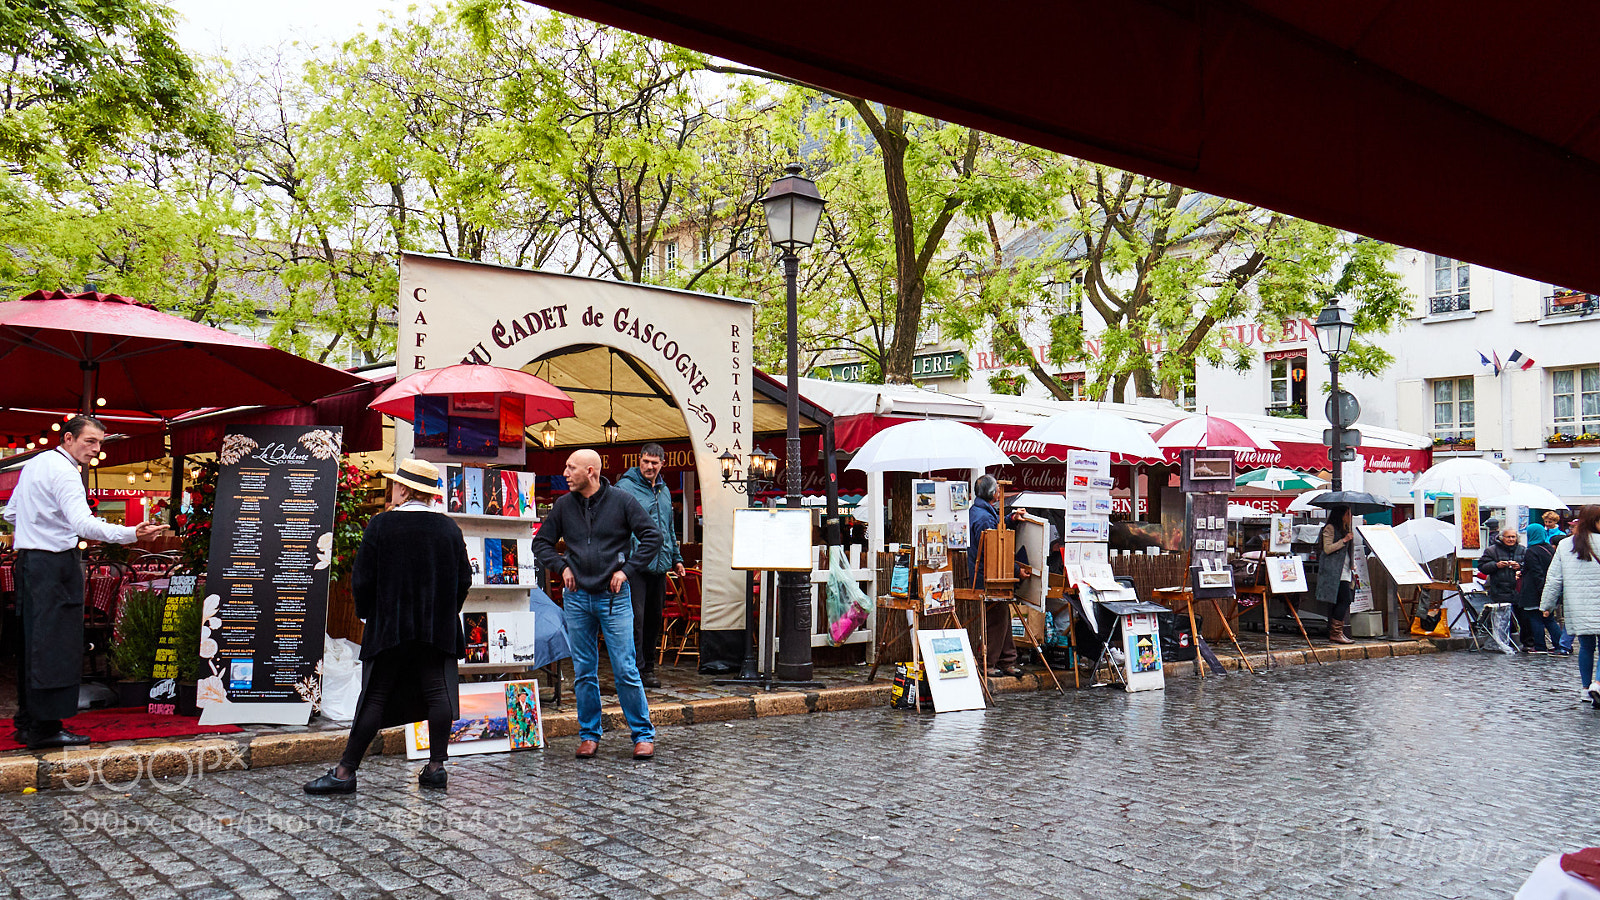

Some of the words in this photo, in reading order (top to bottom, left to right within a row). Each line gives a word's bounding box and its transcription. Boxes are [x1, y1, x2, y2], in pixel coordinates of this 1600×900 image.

[413, 287, 427, 370] CAFE
[491, 304, 568, 349] CADET
[582, 306, 604, 328] de
[613, 307, 709, 395] GASCOGNE
[731, 324, 743, 481] RESTAURANT
